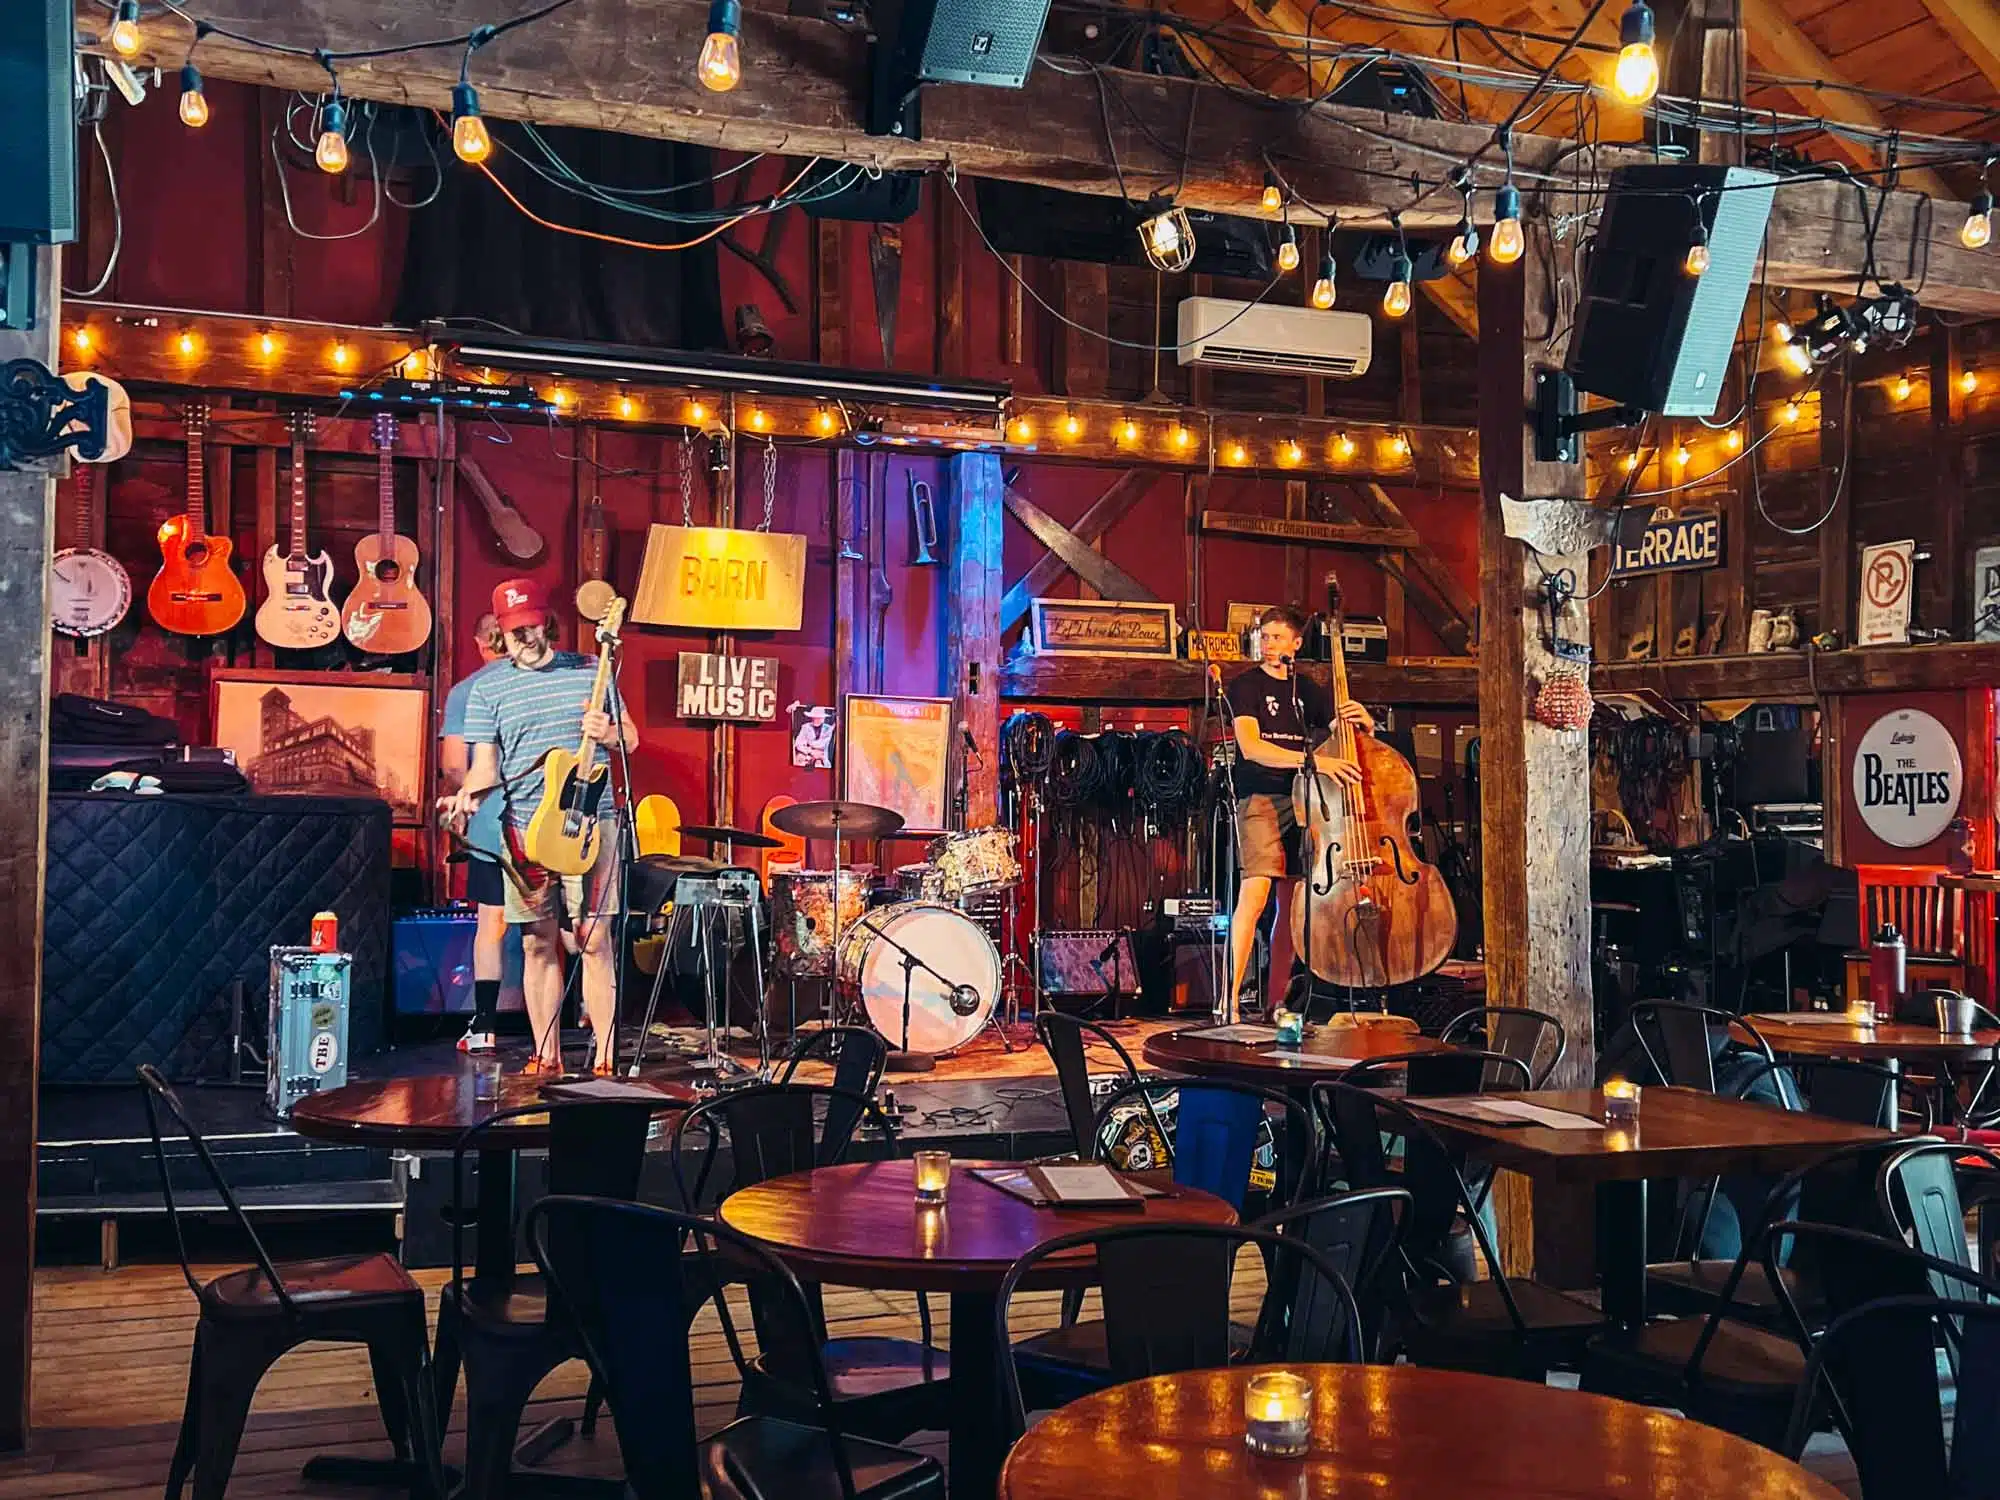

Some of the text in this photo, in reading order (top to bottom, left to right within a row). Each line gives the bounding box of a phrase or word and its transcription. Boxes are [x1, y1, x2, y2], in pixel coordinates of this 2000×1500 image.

[681, 555, 768, 602] BARN
[1127, 621, 1161, 641] Peace
[699, 653, 766, 689] LIVE
[682, 684, 777, 718] MUSIC
[1890, 731, 1917, 745] Ludwig
[1896, 758, 1917, 769] THE
[1863, 753, 1950, 817] BEATLES
[315, 1036, 330, 1069] TBE
